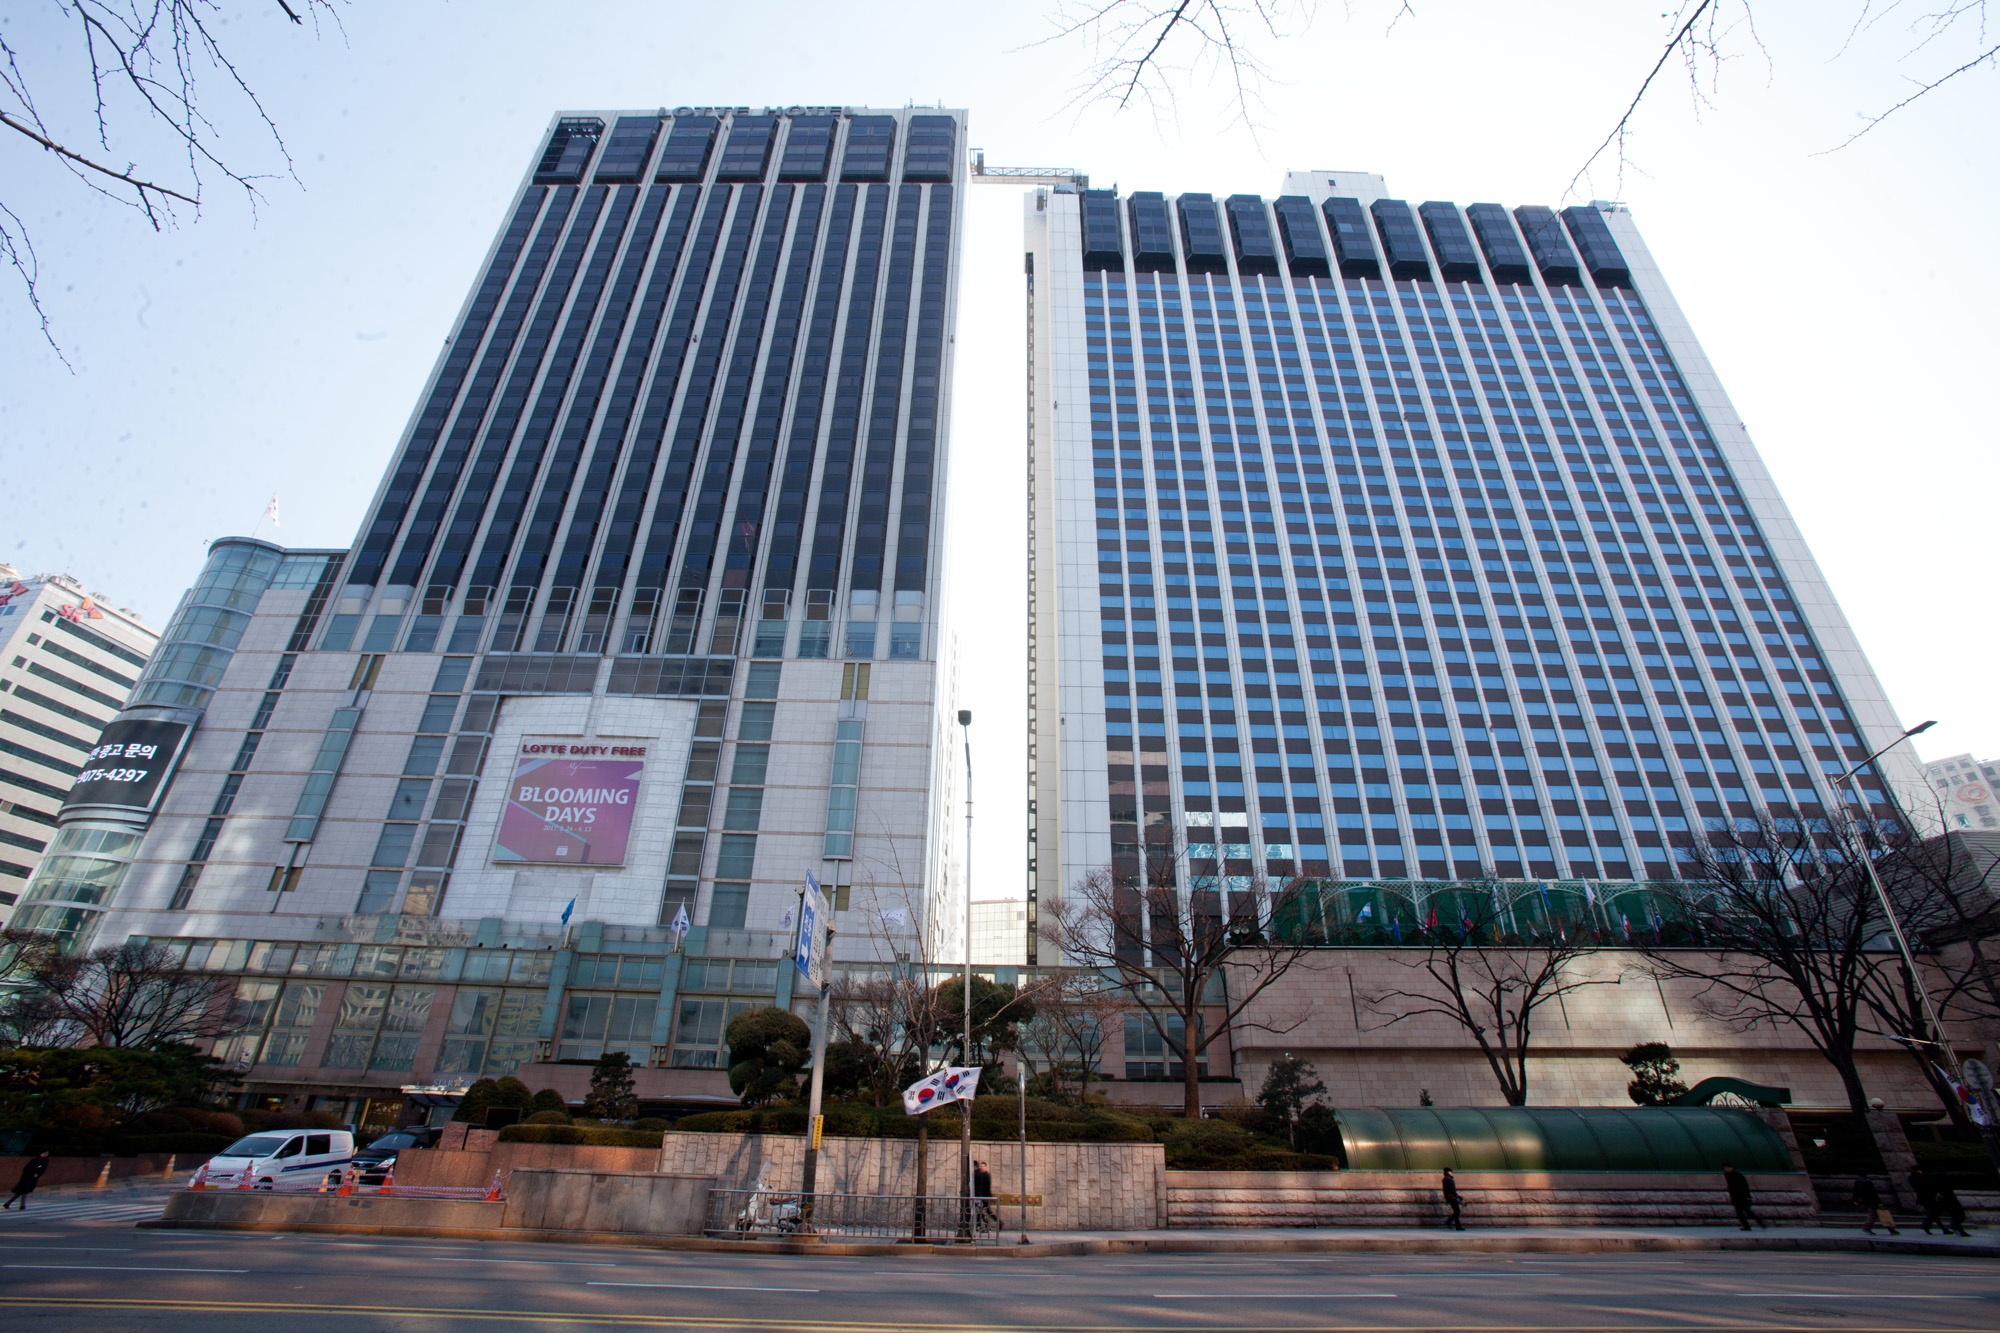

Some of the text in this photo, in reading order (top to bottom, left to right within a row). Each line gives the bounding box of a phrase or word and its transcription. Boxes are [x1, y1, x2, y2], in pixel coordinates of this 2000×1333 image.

[657, 106, 859, 118] LOTTE HOTEL
[58, 604, 85, 623] SK
[124, 743, 158, 760] 문의
[522, 744, 647, 756] LOTTE DUTY FREE
[519, 786, 630, 804] BLOOMING
[545, 806, 597, 824] DAYS
[433, 1079, 454, 1087] STAR
